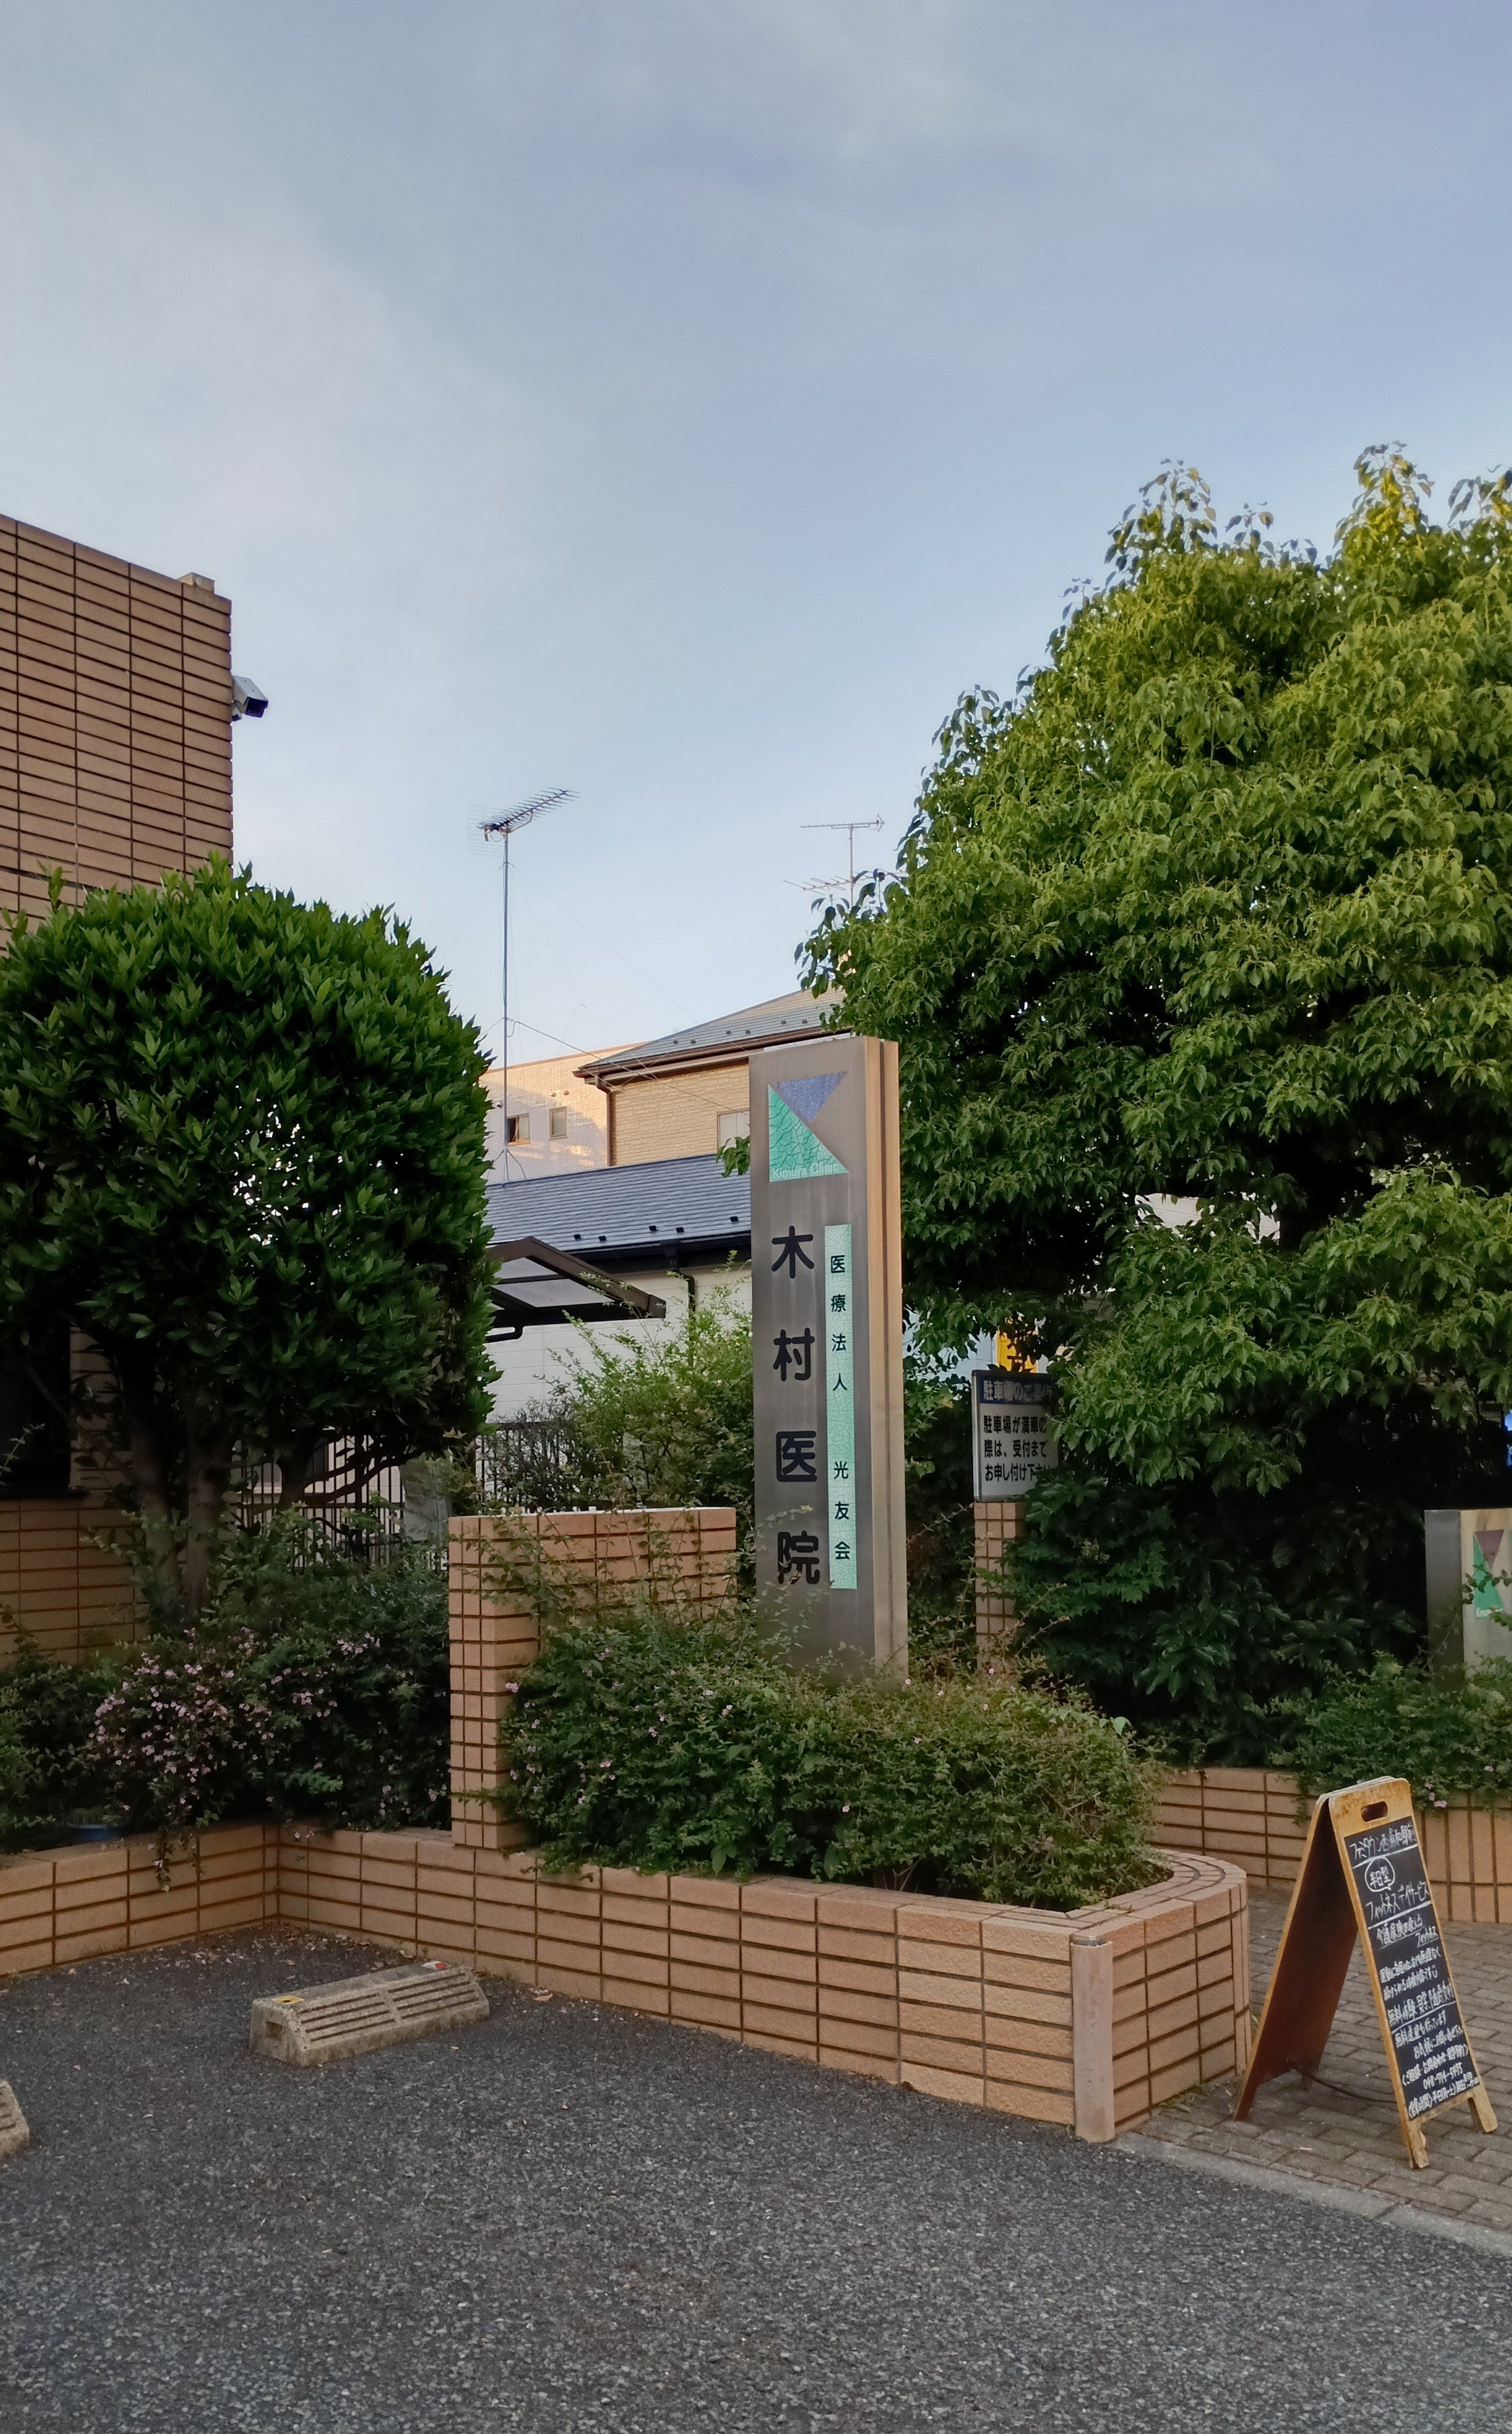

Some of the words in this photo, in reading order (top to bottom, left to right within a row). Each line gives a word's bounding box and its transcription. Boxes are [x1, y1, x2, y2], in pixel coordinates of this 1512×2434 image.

[773, 1167, 807, 1179] Kimura
[830, 1254, 848, 1392] 医療法人
[771, 1225, 821, 1585] 木村医院
[984, 1415, 1047, 1434] 駐車場が満車の
[833, 1461, 850, 1561] 光友会
[1370, 1866, 1391, 1888] 半日型
